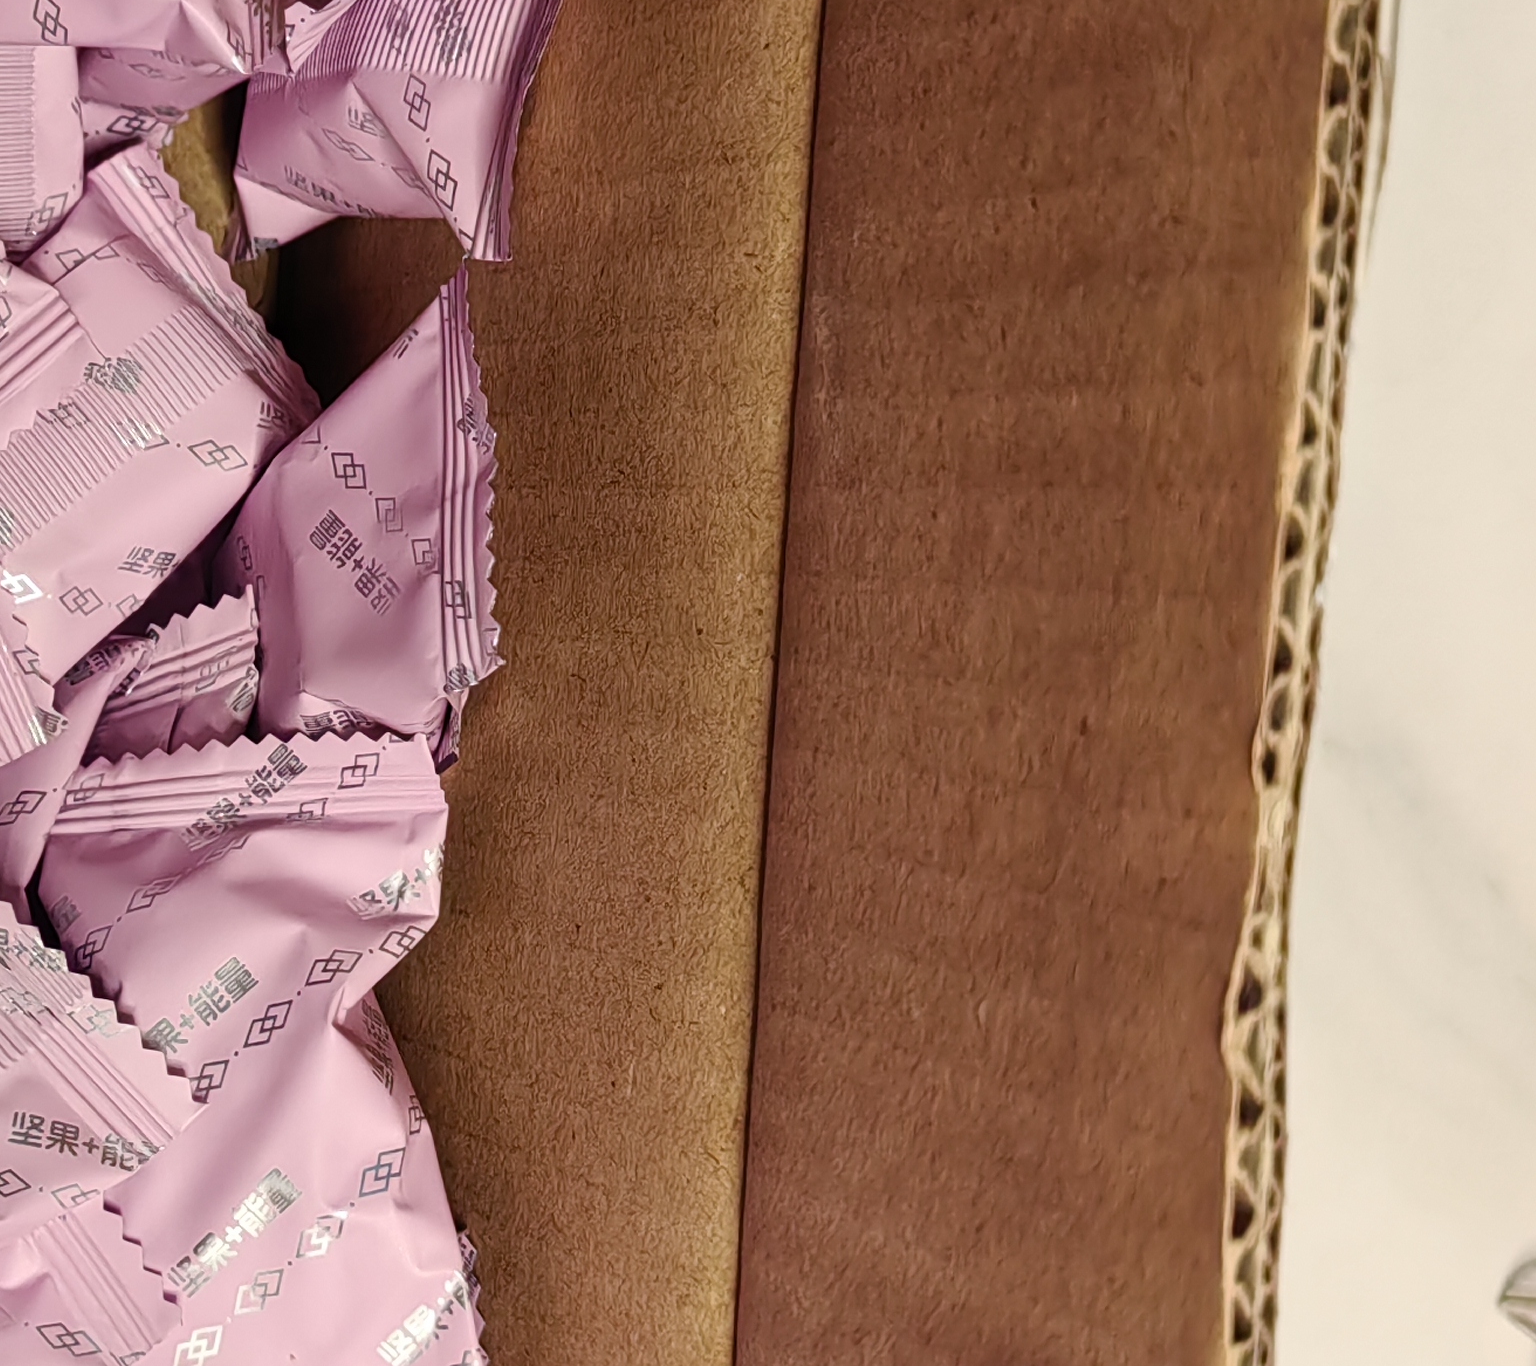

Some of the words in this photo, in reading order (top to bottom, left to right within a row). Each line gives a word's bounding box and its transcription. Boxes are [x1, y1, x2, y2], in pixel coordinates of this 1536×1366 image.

[117, 544, 180, 579] 坚果
[308, 509, 402, 617] 坚果+能量
[167, 1167, 304, 1299] 坚果+能量
